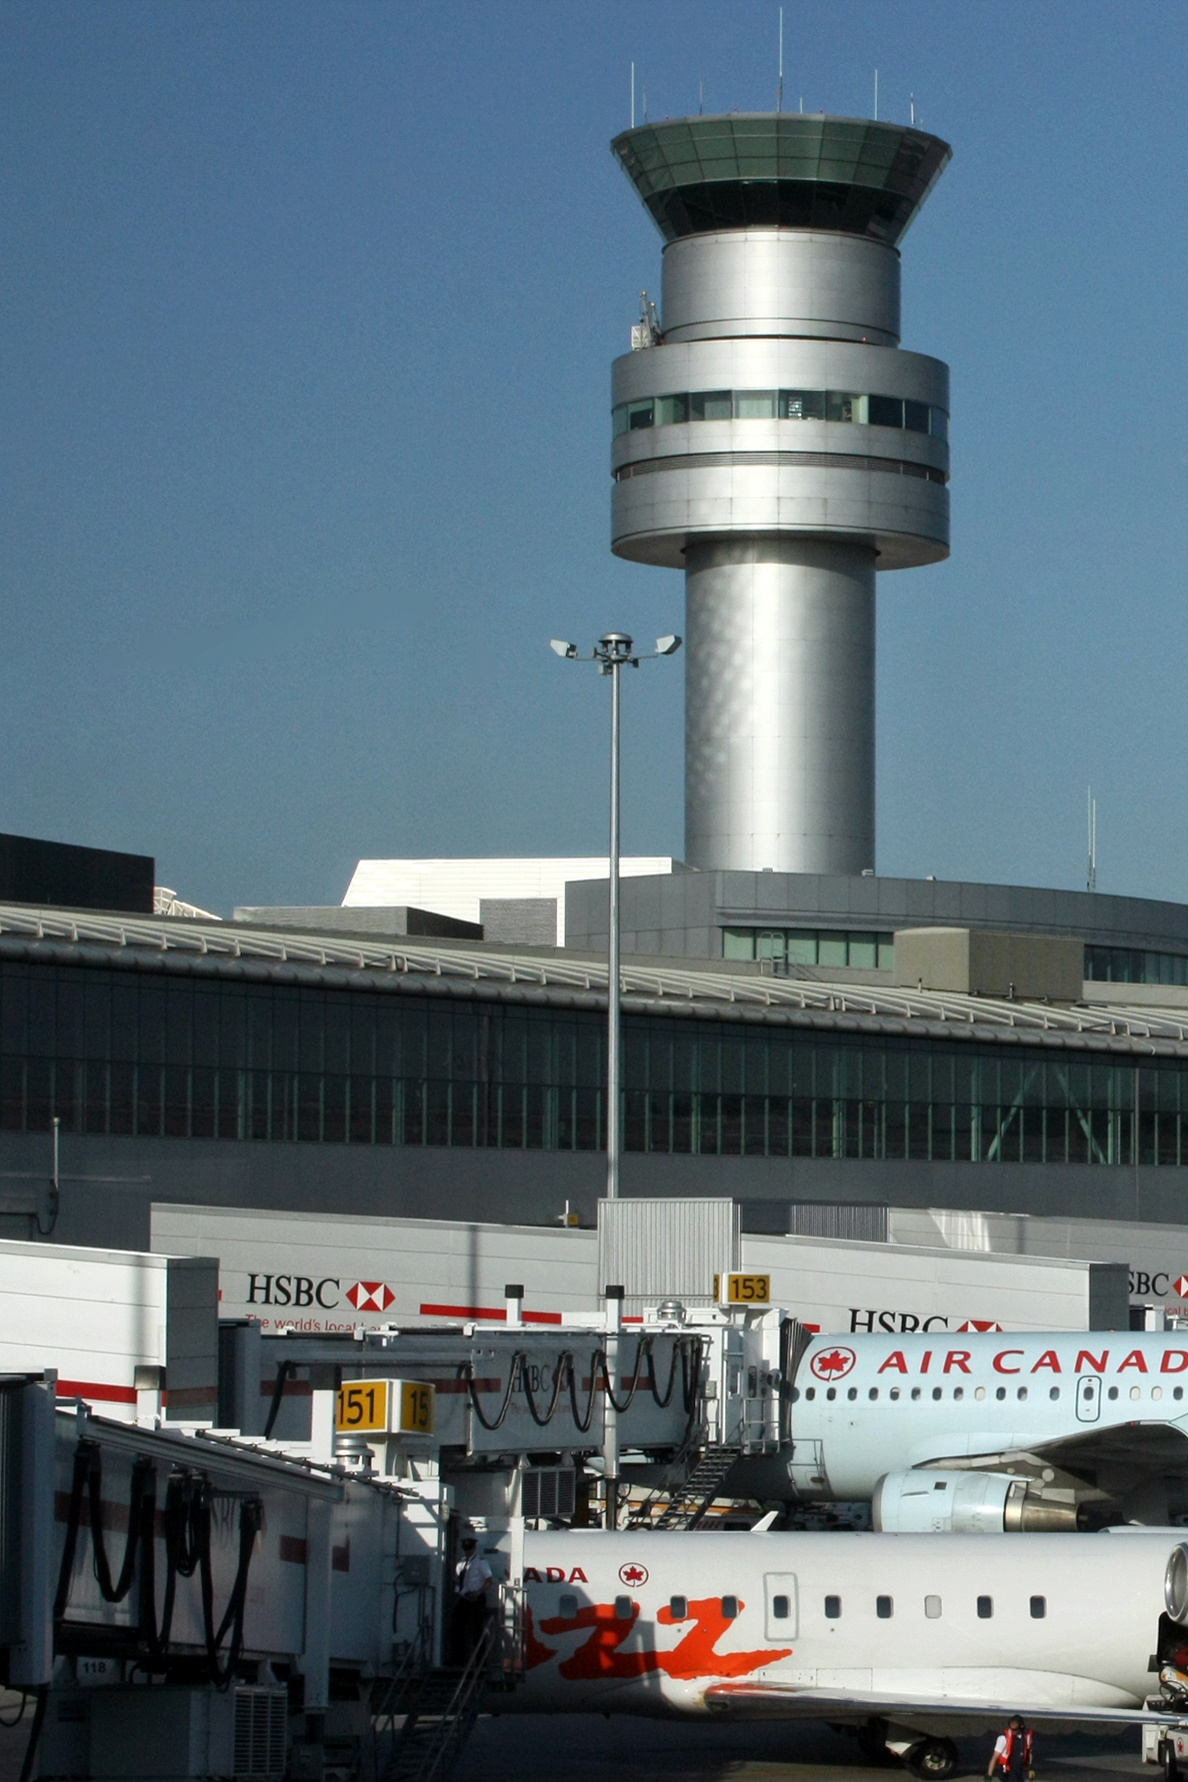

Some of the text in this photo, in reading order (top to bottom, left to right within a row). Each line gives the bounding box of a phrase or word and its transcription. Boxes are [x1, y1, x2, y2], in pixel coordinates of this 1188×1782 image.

[246, 1273, 340, 1309] HSBC
[732, 1278, 768, 1299] 153
[848, 1308, 949, 1333] HSBC
[876, 1350, 972, 1375] AIR
[512, 1364, 551, 1393] HBC
[338, 1388, 375, 1425] 151
[83, 1661, 107, 1674] 118
